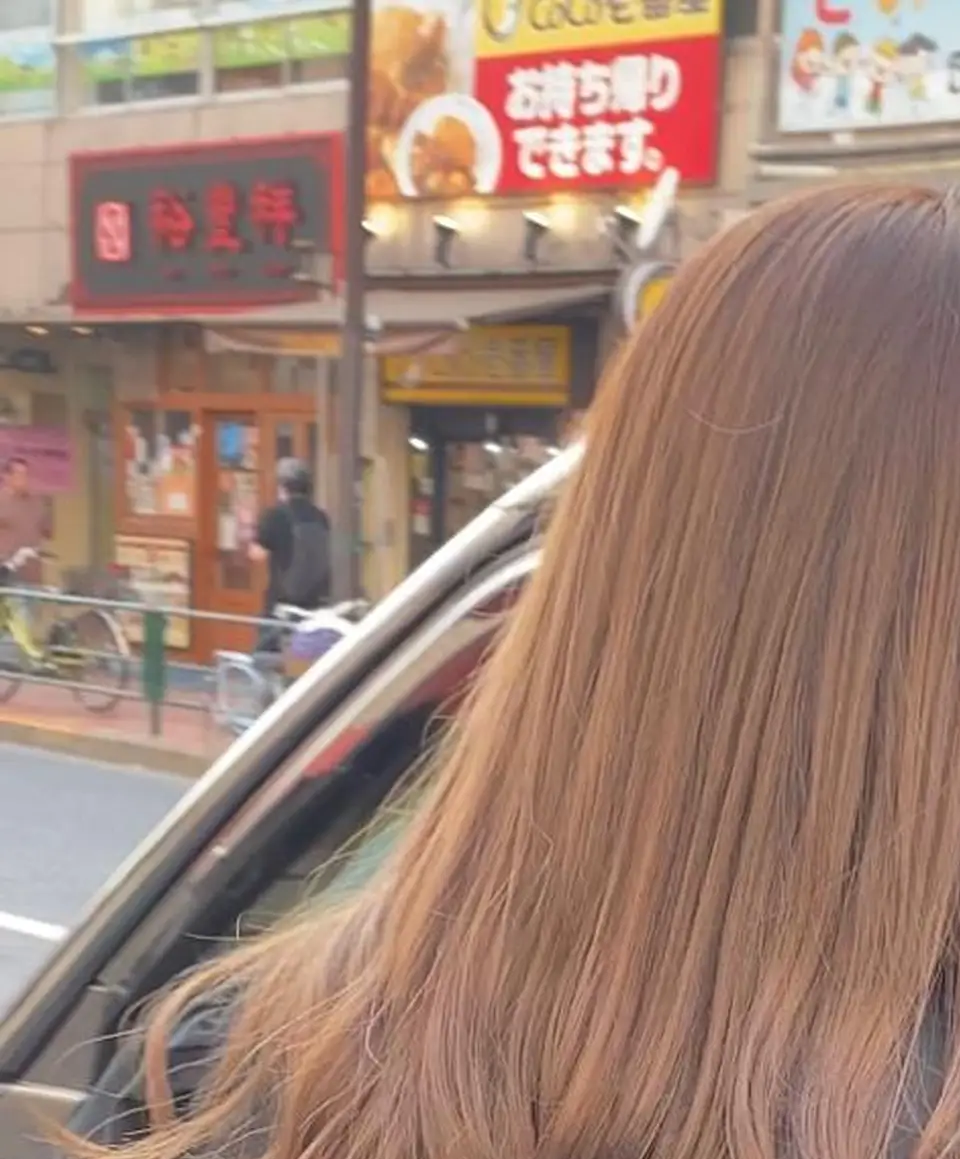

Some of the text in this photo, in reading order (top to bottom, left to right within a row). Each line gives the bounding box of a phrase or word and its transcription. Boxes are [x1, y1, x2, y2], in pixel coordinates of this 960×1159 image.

[504, 52, 682, 121] お持ち帰り
[513, 116, 665, 180] できます。
